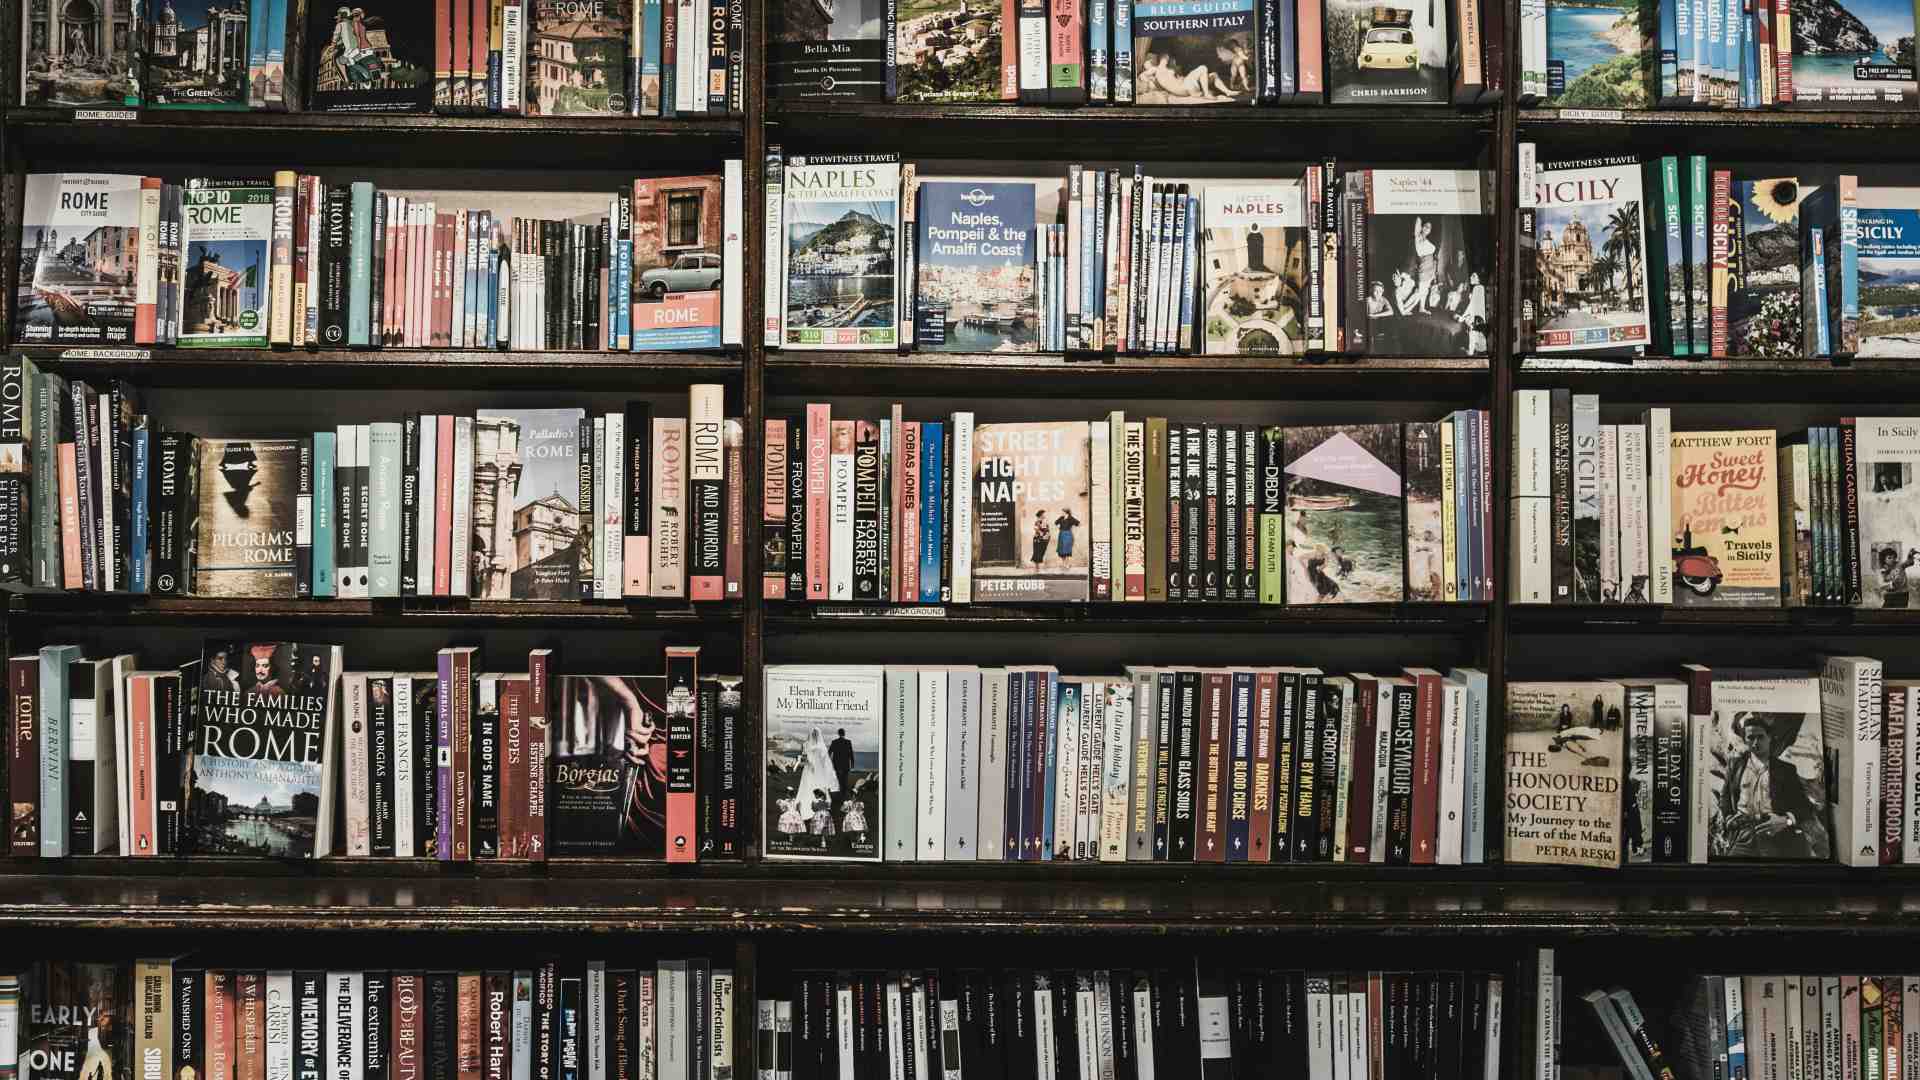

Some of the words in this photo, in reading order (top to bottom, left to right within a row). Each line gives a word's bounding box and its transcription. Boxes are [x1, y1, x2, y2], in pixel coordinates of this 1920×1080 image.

[555, 2, 600, 15] ROME
[712, 7, 724, 57] ROME
[1143, 19, 1209, 31] SOUTHERN
[1213, 16, 1245, 27] ITALY
[804, 45, 828, 54] Bella
[831, 44, 850, 53] Mia
[1352, 88, 1379, 96] CHRIS
[1382, 87, 1428, 96] HARRISON
[810, 155, 863, 164] EYEWITNESS
[1548, 159, 1602, 170] EYEWITNESS
[1605, 155, 1637, 165] TRAVEL
[789, 170, 876, 189] NAPLES
[61, 192, 109, 210] ROME
[247, 194, 270, 202] 2018
[1223, 203, 1284, 214] NAPLES
[1326, 188, 1335, 228] TRAVELER
[188, 207, 242, 224] ROME
[330, 202, 342, 248] ROME
[621, 198, 629, 231] MOON
[951, 212, 1003, 226] Naples,
[1667, 205, 1679, 238] SICILY
[1694, 205, 1704, 239] SICILY
[160, 220, 168, 245] ROME
[169, 222, 178, 248] ROME
[928, 226, 984, 242] Pompeii
[989, 227, 999, 240] &
[1003, 226, 1026, 240] the
[1713, 223, 1728, 269] SICILY
[1857, 226, 1903, 240] SICILY
[932, 243, 977, 255] Amalfi
[980, 243, 1023, 256] Coast
[654, 307, 699, 324] ROME
[2, 367, 21, 438] ROME
[980, 430, 1065, 451] STREET
[1128, 429, 1140, 445] THE
[1671, 437, 1732, 448] MATTHEW
[1737, 436, 1772, 446] FORT
[1878, 427, 1888, 437] In
[1892, 426, 1918, 439] Sicily
[525, 446, 574, 458] ROME
[695, 422, 719, 475] ROME
[905, 428, 915, 470] TOBIAS
[1560, 423, 1569, 472] SYRACUSE
[1711, 450, 1765, 465] Sweet
[163, 451, 175, 496] ROME
[662, 429, 681, 499] ROME
[767, 444, 784, 506] POMPEII
[811, 438, 825, 494] POMPEII
[980, 456, 1040, 477] FIGHT
[1127, 447, 1141, 481] SOUTH
[1577, 436, 1595, 508] SICILY
[405, 475, 415, 506] Rome
[792, 462, 802, 499] FROM
[837, 460, 848, 523] POMPEII
[856, 446, 876, 512] POMPEII
[905, 472, 915, 510] JONES
[980, 481, 1065, 503] NAPLES
[1265, 467, 1278, 512] DIBDIN
[704, 485, 719, 508] AND
[0, 481, 8, 556] HIBBERT
[792, 504, 801, 560] POMPEII
[1127, 498, 1141, 541] WINTER
[1560, 500, 1568, 546] LEGENDS
[212, 531, 293, 546] PILGRIM'S
[342, 522, 350, 548] ROME
[360, 521, 368, 548] ROME
[660, 520, 669, 568] HUGHES
[670, 522, 679, 568] ROBERT
[704, 512, 719, 568] ENVIRONS
[856, 519, 866, 576] HARRIS
[866, 519, 877, 576] ROBERT
[1724, 540, 1773, 551] Travels
[243, 549, 293, 562] ROME
[1736, 550, 1772, 562] Sicily
[980, 579, 1014, 591] PETER
[1017, 580, 1045, 591] ROBB
[204, 690, 240, 706] THE
[247, 693, 323, 711] FAMILIES
[398, 683, 408, 718] POPE
[776, 699, 794, 711] My
[796, 698, 834, 711] Brilliant
[836, 699, 869, 712] Friend
[789, 686, 815, 696] Elena
[817, 686, 856, 698] Ferrante
[1857, 668, 1868, 742] SHADOWS
[1870, 668, 1880, 742] SICILIAN
[20, 695, 33, 741] rome
[204, 706, 257, 725] WHO
[264, 710, 320, 730] MADE
[375, 706, 385, 727] THE
[1398, 692, 1412, 728] GERALD
[1888, 692, 1905, 738] MAFIA
[482, 722, 492, 736] IN
[508, 719, 520, 764] POPES
[48, 717, 58, 781] BERNINI
[202, 724, 321, 763] ROME
[375, 730, 386, 777] BORGIAS
[398, 723, 409, 782] FRANCIS
[482, 738, 493, 770] GOD'S
[1301, 762, 1314, 774] BY
[1392, 729, 1412, 794] SEYMOUR
[1509, 752, 1548, 768] THE
[1657, 737, 1669, 789] BATTLE
[1178, 761, 1191, 788] GLASS
[1234, 761, 1247, 789] BLOOD
[1254, 763, 1269, 811] DARKNESS
[1300, 776, 1312, 790] MY
[1508, 773, 1618, 793] HONOURED
[482, 774, 492, 807] NAME
[1176, 790, 1189, 819] SOULS
[1298, 792, 1312, 816] HAND
[1507, 794, 1587, 812] SOCIETY
[1885, 739, 1904, 844] BROTHERHOODS
[1232, 791, 1246, 820] CURSE
[1507, 827, 1540, 838] Heart
[1544, 826, 1555, 840] of
[1559, 829, 1577, 840] the
[1581, 830, 1613, 844] Mafia
[1508, 814, 1526, 826] My
[1530, 814, 1574, 828] Journey
[1579, 817, 1590, 827] to
[1594, 817, 1612, 828] the
[1536, 845, 1578, 857] PETRA
[1581, 847, 1616, 861] RESKI
[304, 980, 315, 995] THE
[338, 977, 350, 994] THE
[368, 980, 384, 1001] the
[31, 1004, 96, 1026] EARLY
[182, 985, 192, 1030] VANISHED
[268, 990, 281, 1044] CARRISI
[490, 991, 504, 1037] Robert
[541, 1012, 550, 1024] THE
[714, 978, 725, 1057] Imperfectionists
[301, 998, 319, 1057] MEMORY
[337, 995, 351, 1069] DELIVERANCE
[368, 1005, 380, 1070] extremist
[183, 1032, 192, 1060] ONES
[540, 1026, 550, 1065] STORY
[30, 1049, 75, 1072] ONE
[304, 1058, 313, 1068] OF
[540, 1067, 549, 1080] OF
